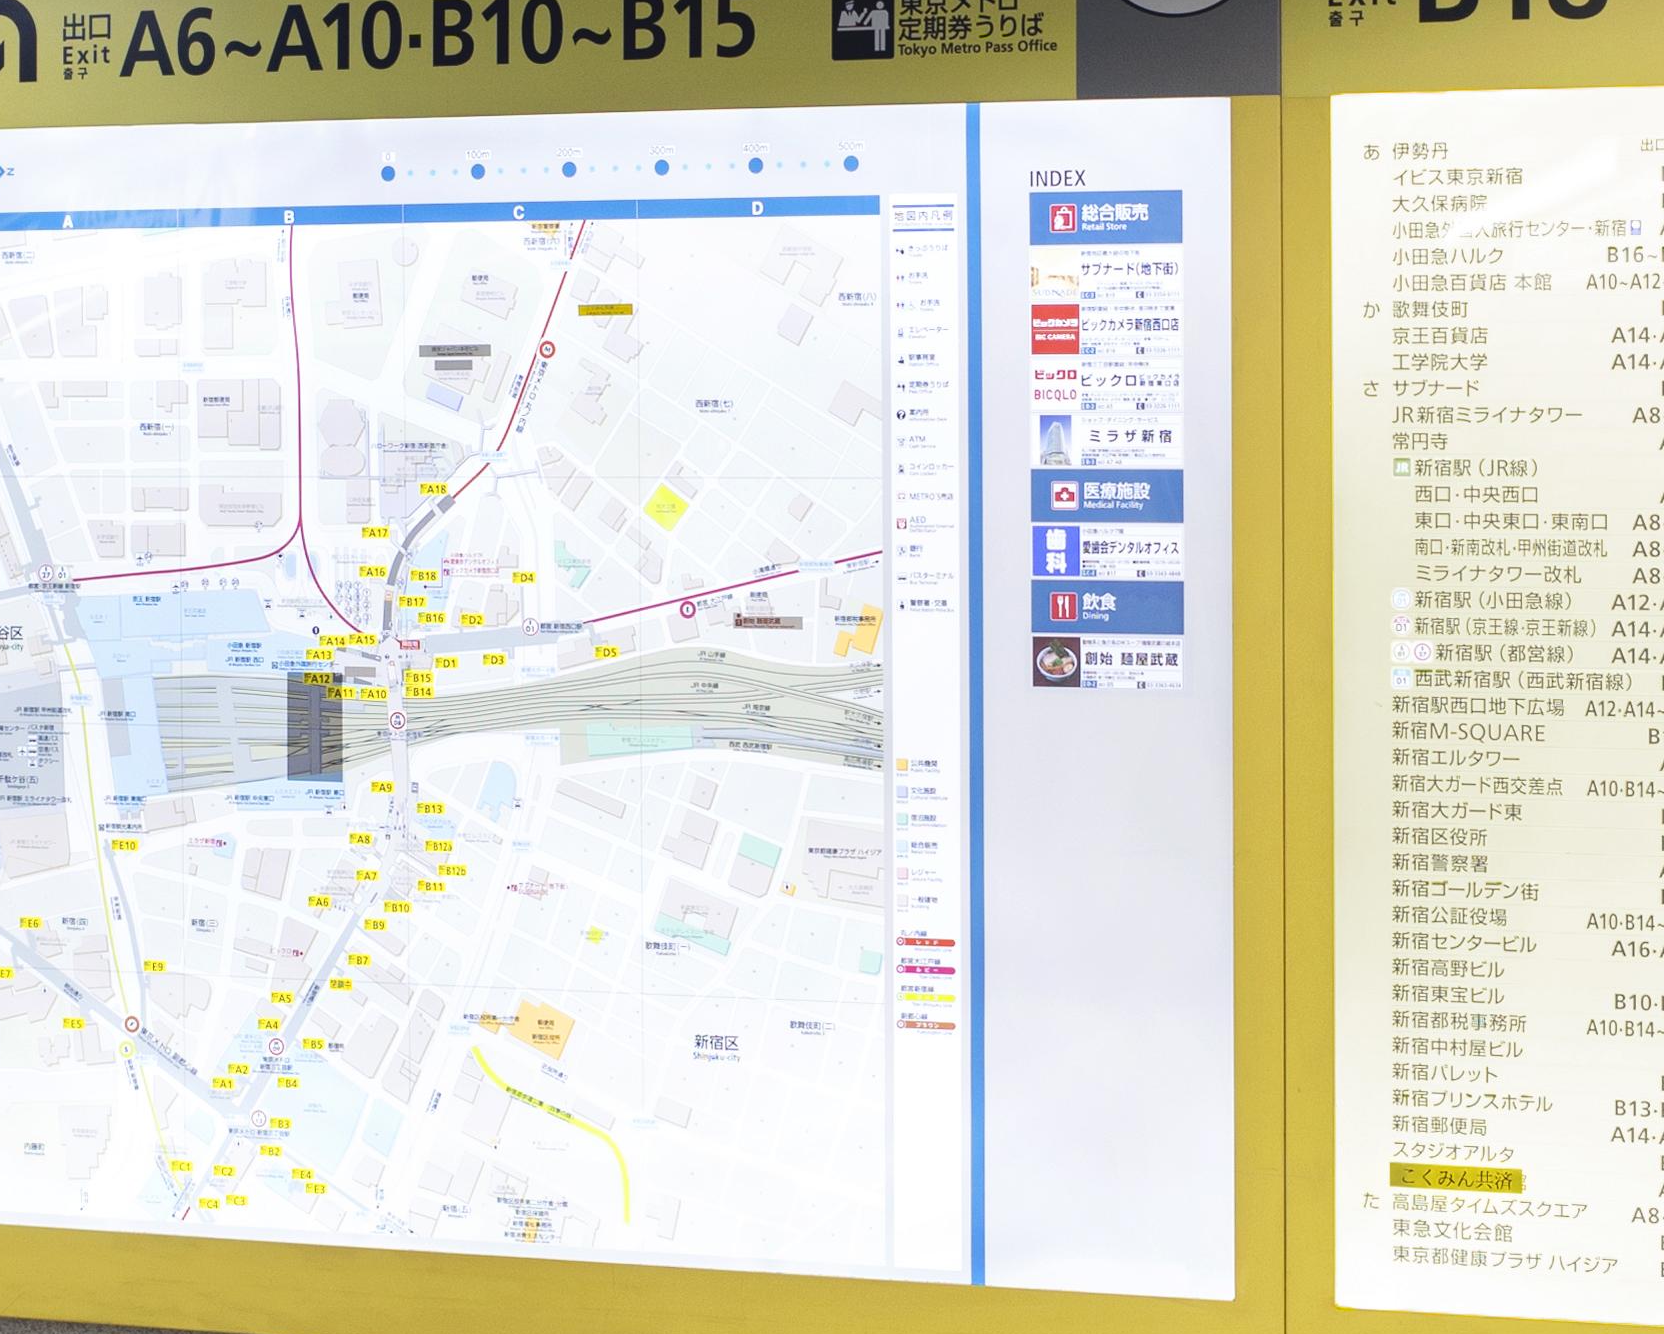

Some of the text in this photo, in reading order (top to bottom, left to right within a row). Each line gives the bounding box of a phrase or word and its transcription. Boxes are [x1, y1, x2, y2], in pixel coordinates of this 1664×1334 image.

[63, 14, 111, 41] 出口
[898, 12, 1044, 41] 定期券うりば
[63, 44, 110, 64] Exit
[897, 39, 1058, 58] Tokyo Metro Pass Office
[1364, 142, 1448, 160] あ 伊勢丹
[1031, 170, 1085, 187] INDEX
[1394, 167, 1523, 186] イビス東京新宿
[284, 210, 294, 224] B
[514, 205, 524, 219] C
[752, 201, 763, 215] D
[1082, 203, 1148, 222] 総合販売
[63, 215, 74, 228] A
[1392, 353, 1487, 371] 工学院大学
[1081, 375, 1136, 386] ビックロ
[1034, 389, 1076, 401] BICQLO
[1090, 430, 1172, 443] ミラザ新宿
[1084, 482, 1150, 500] 医療施設
[1116, 501, 1143, 510] Facility
[1083, 593, 1116, 611] 飲食
[1083, 612, 1109, 621] Dining
[1393, 721, 1544, 743] 新宿M-SQUARE
[1393, 853, 1487, 873] 新宿警察署
[1392, 984, 1504, 1004] 新宿東宝ビル
[695, 1035, 738, 1051] 新宿区
[1402, 1169, 1512, 1190] こくみん共済
[1394, 1246, 1618, 1273] 東京都健康プラザ ハイジア
